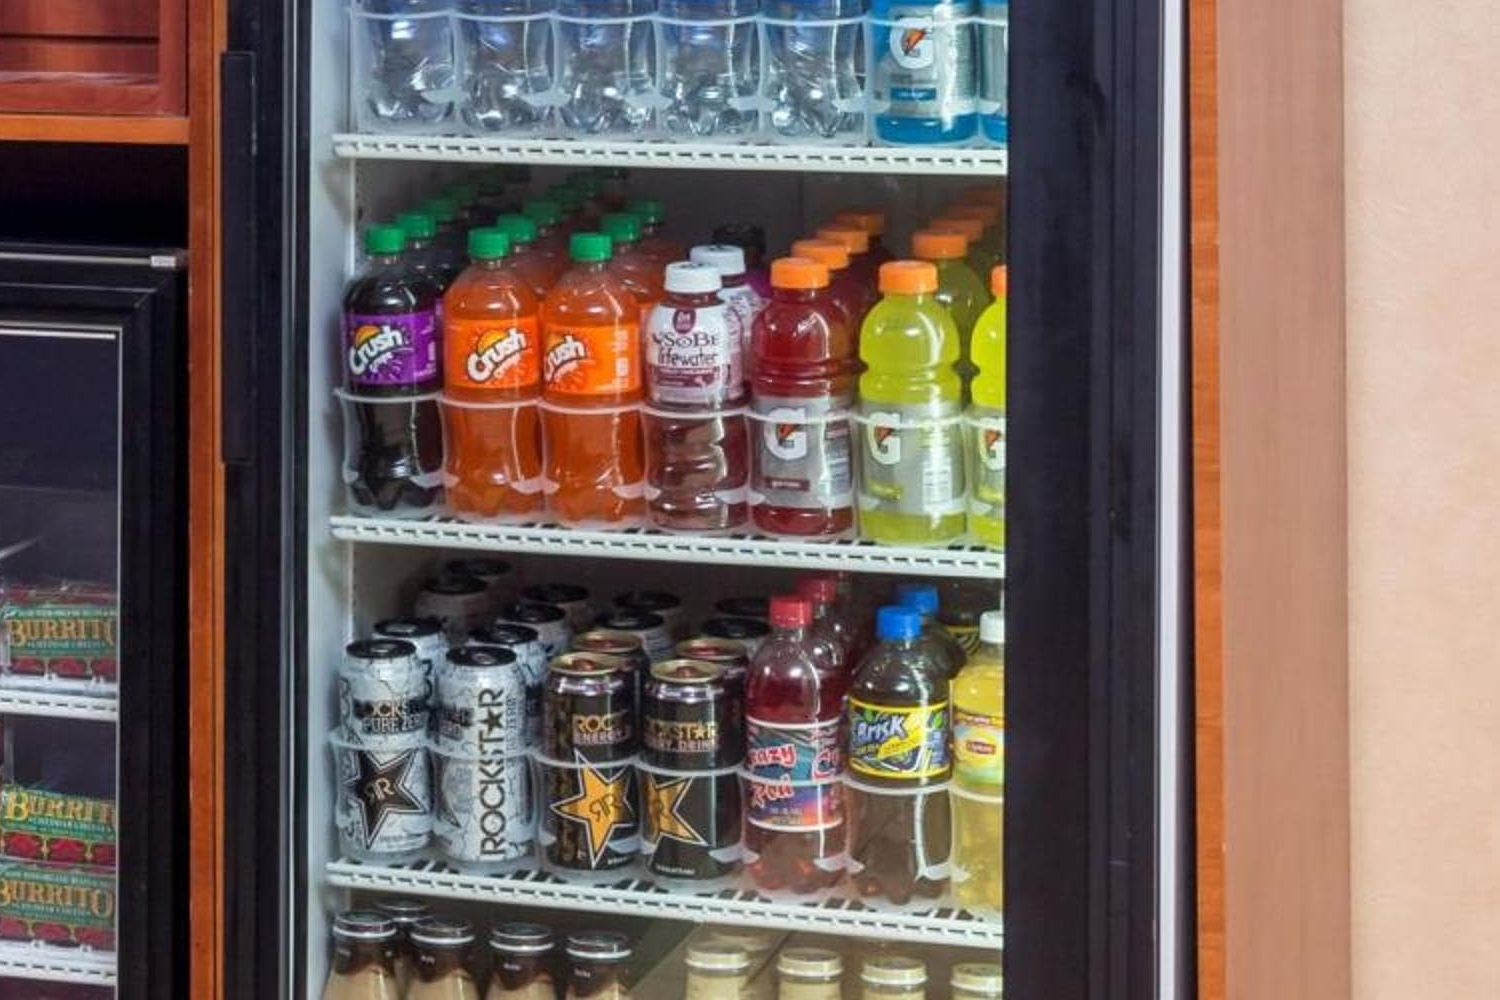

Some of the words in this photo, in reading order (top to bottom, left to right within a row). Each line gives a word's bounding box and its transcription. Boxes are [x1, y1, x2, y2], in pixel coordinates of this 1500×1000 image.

[349, 325, 404, 376] Crush
[467, 327, 528, 382] Crush
[764, 406, 808, 461] G
[867, 411, 902, 466] G
[857, 714, 906, 740] Brisk
[6, 790, 115, 821] BURRIT
